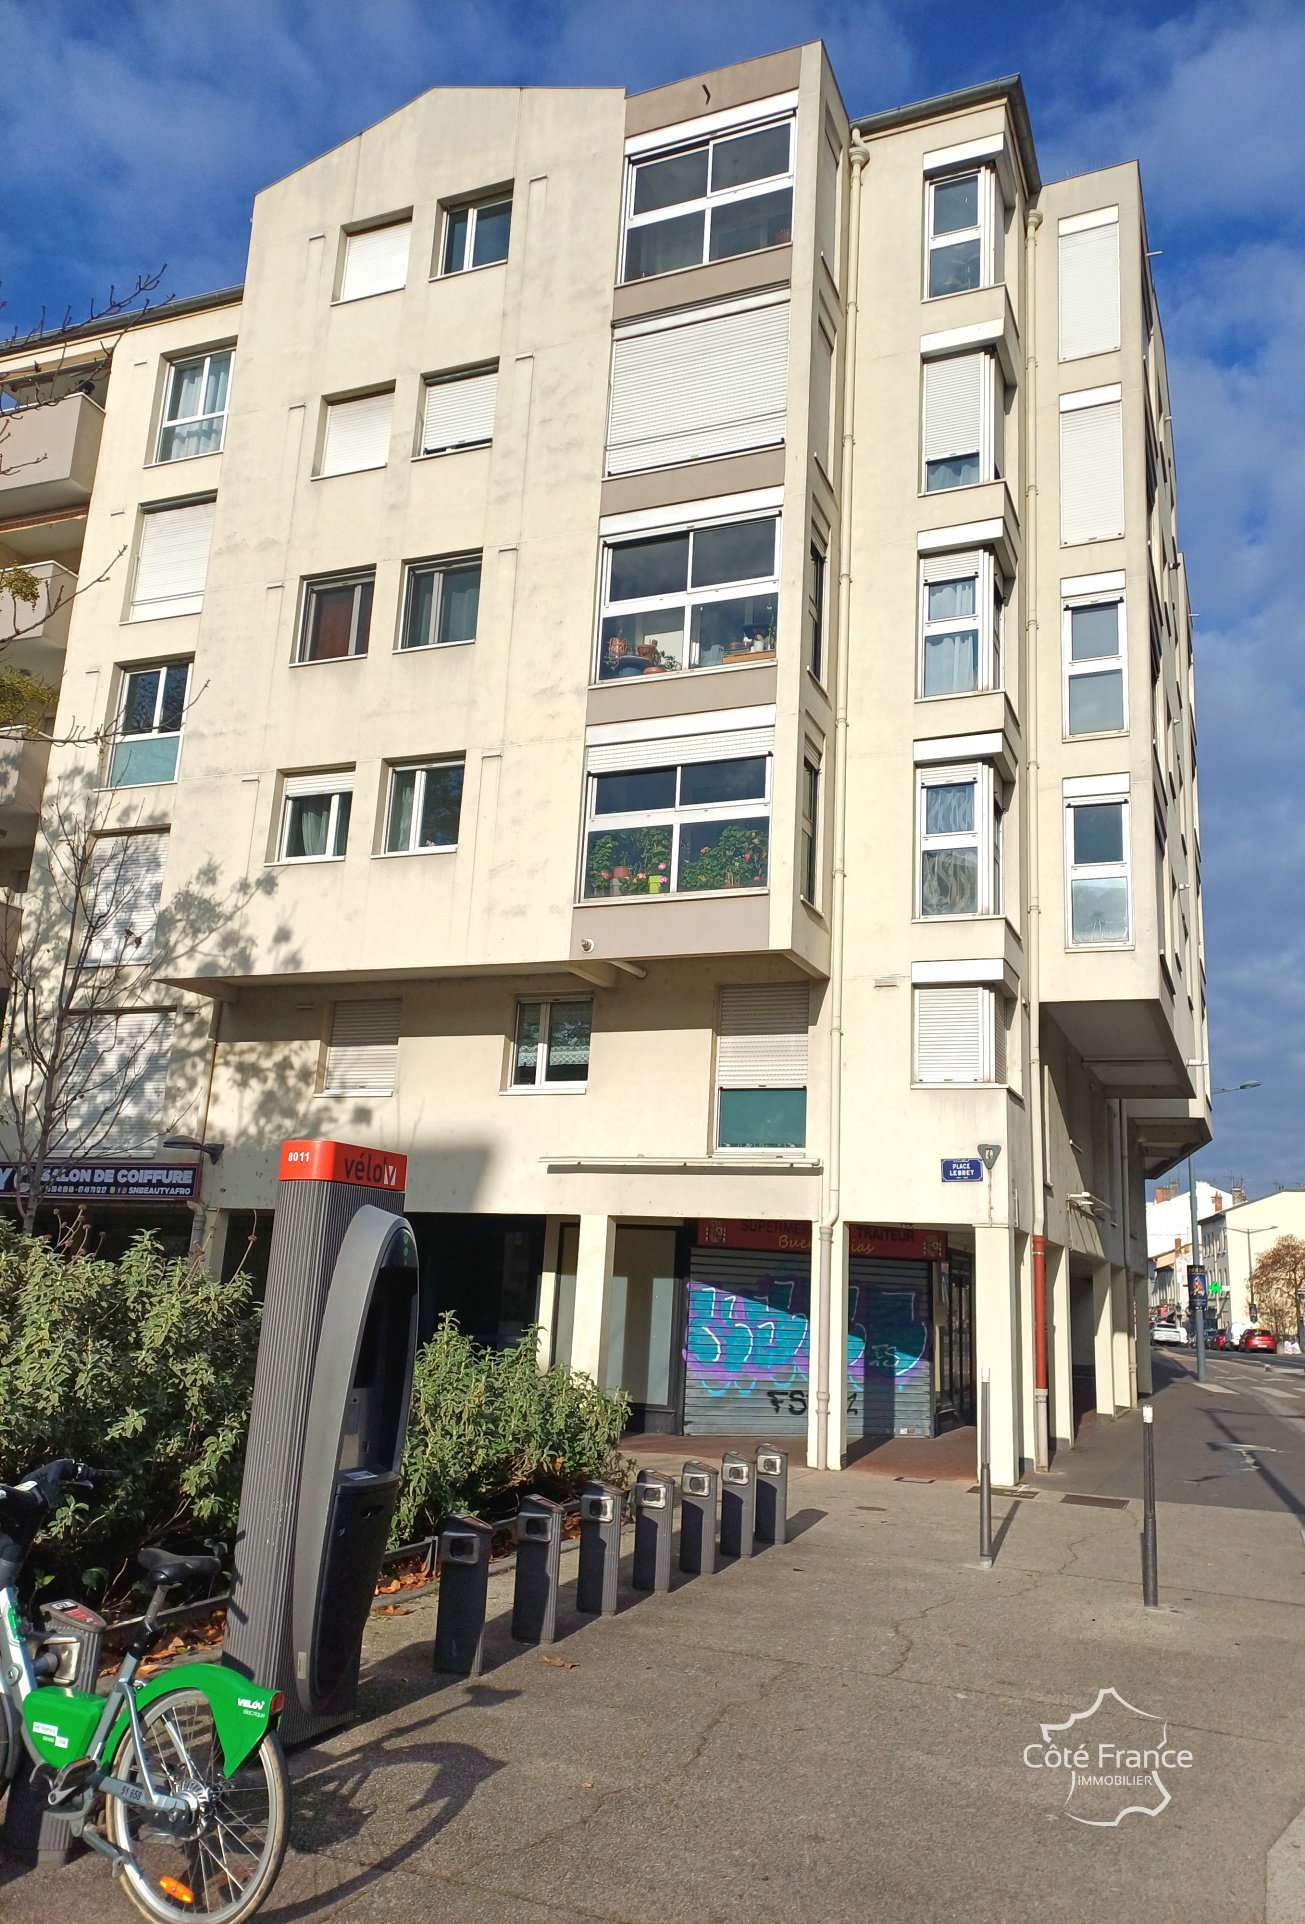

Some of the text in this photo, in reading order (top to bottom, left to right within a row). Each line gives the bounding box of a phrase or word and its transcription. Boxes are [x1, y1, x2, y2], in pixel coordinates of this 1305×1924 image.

[288, 1151, 310, 1162] 8011
[93, 1170, 114, 1183] DE
[117, 1170, 193, 1184] COIFFURE
[778, 1234, 811, 1249] Bue
[857, 1227, 914, 1242] TRAITEUR
